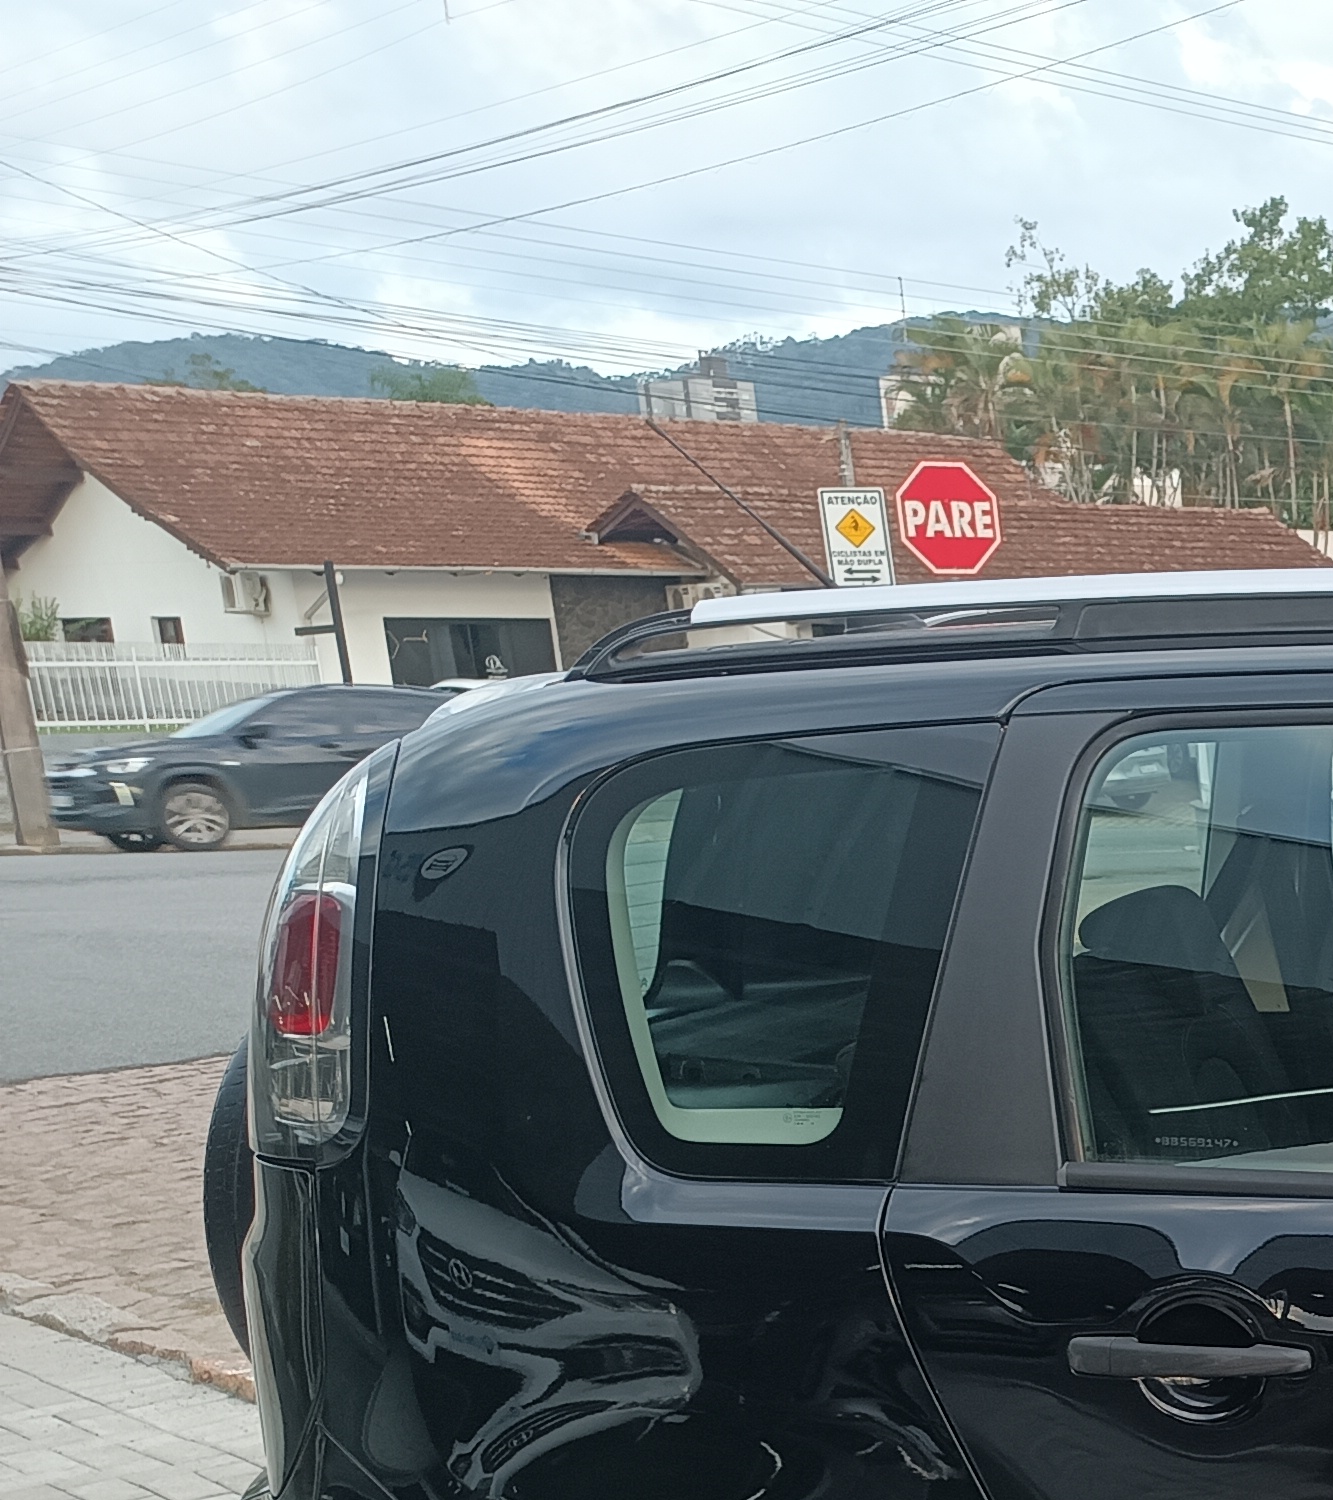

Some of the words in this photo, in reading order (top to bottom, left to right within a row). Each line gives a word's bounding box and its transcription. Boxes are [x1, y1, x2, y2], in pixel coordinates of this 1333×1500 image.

[827, 494, 877, 506] ATENÇÃO
[904, 500, 994, 538] PARE
[832, 550, 872, 558] CICLISTAS
[837, 558, 855, 566] MÃO
[857, 558, 883, 566] DUPLA
